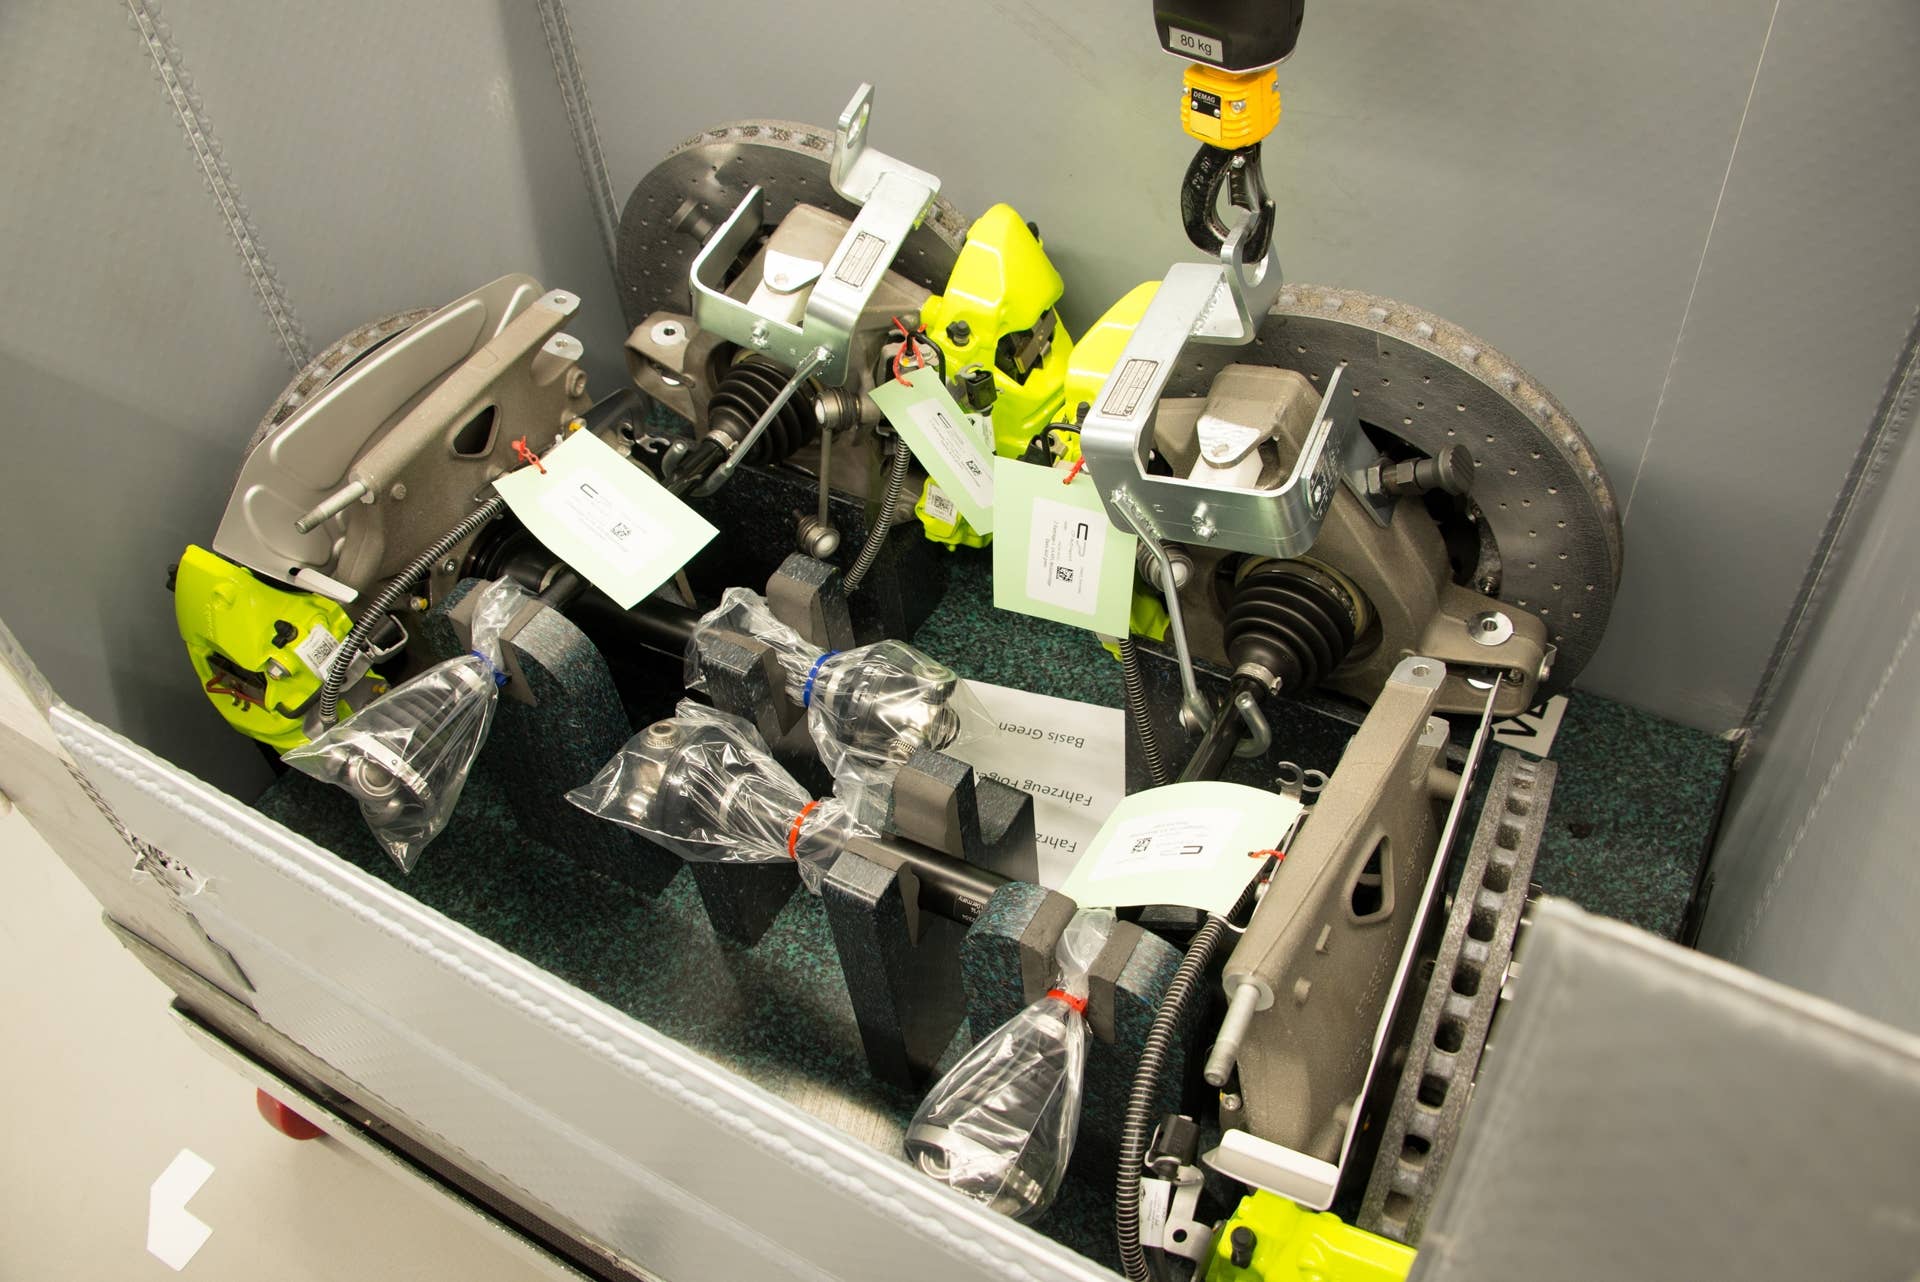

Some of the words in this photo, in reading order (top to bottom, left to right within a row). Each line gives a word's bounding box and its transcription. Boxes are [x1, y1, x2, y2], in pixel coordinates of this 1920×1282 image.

[1180, 34, 1195, 48] 80
[1197, 39, 1212, 56] kg
[1193, 91, 1216, 104] DEMAG
[998, 721, 1043, 740] Green
[1048, 731, 1085, 749] Basis
[1023, 779, 1093, 807] Fahrzeug
[1035, 832, 1077, 853] Fahrz
